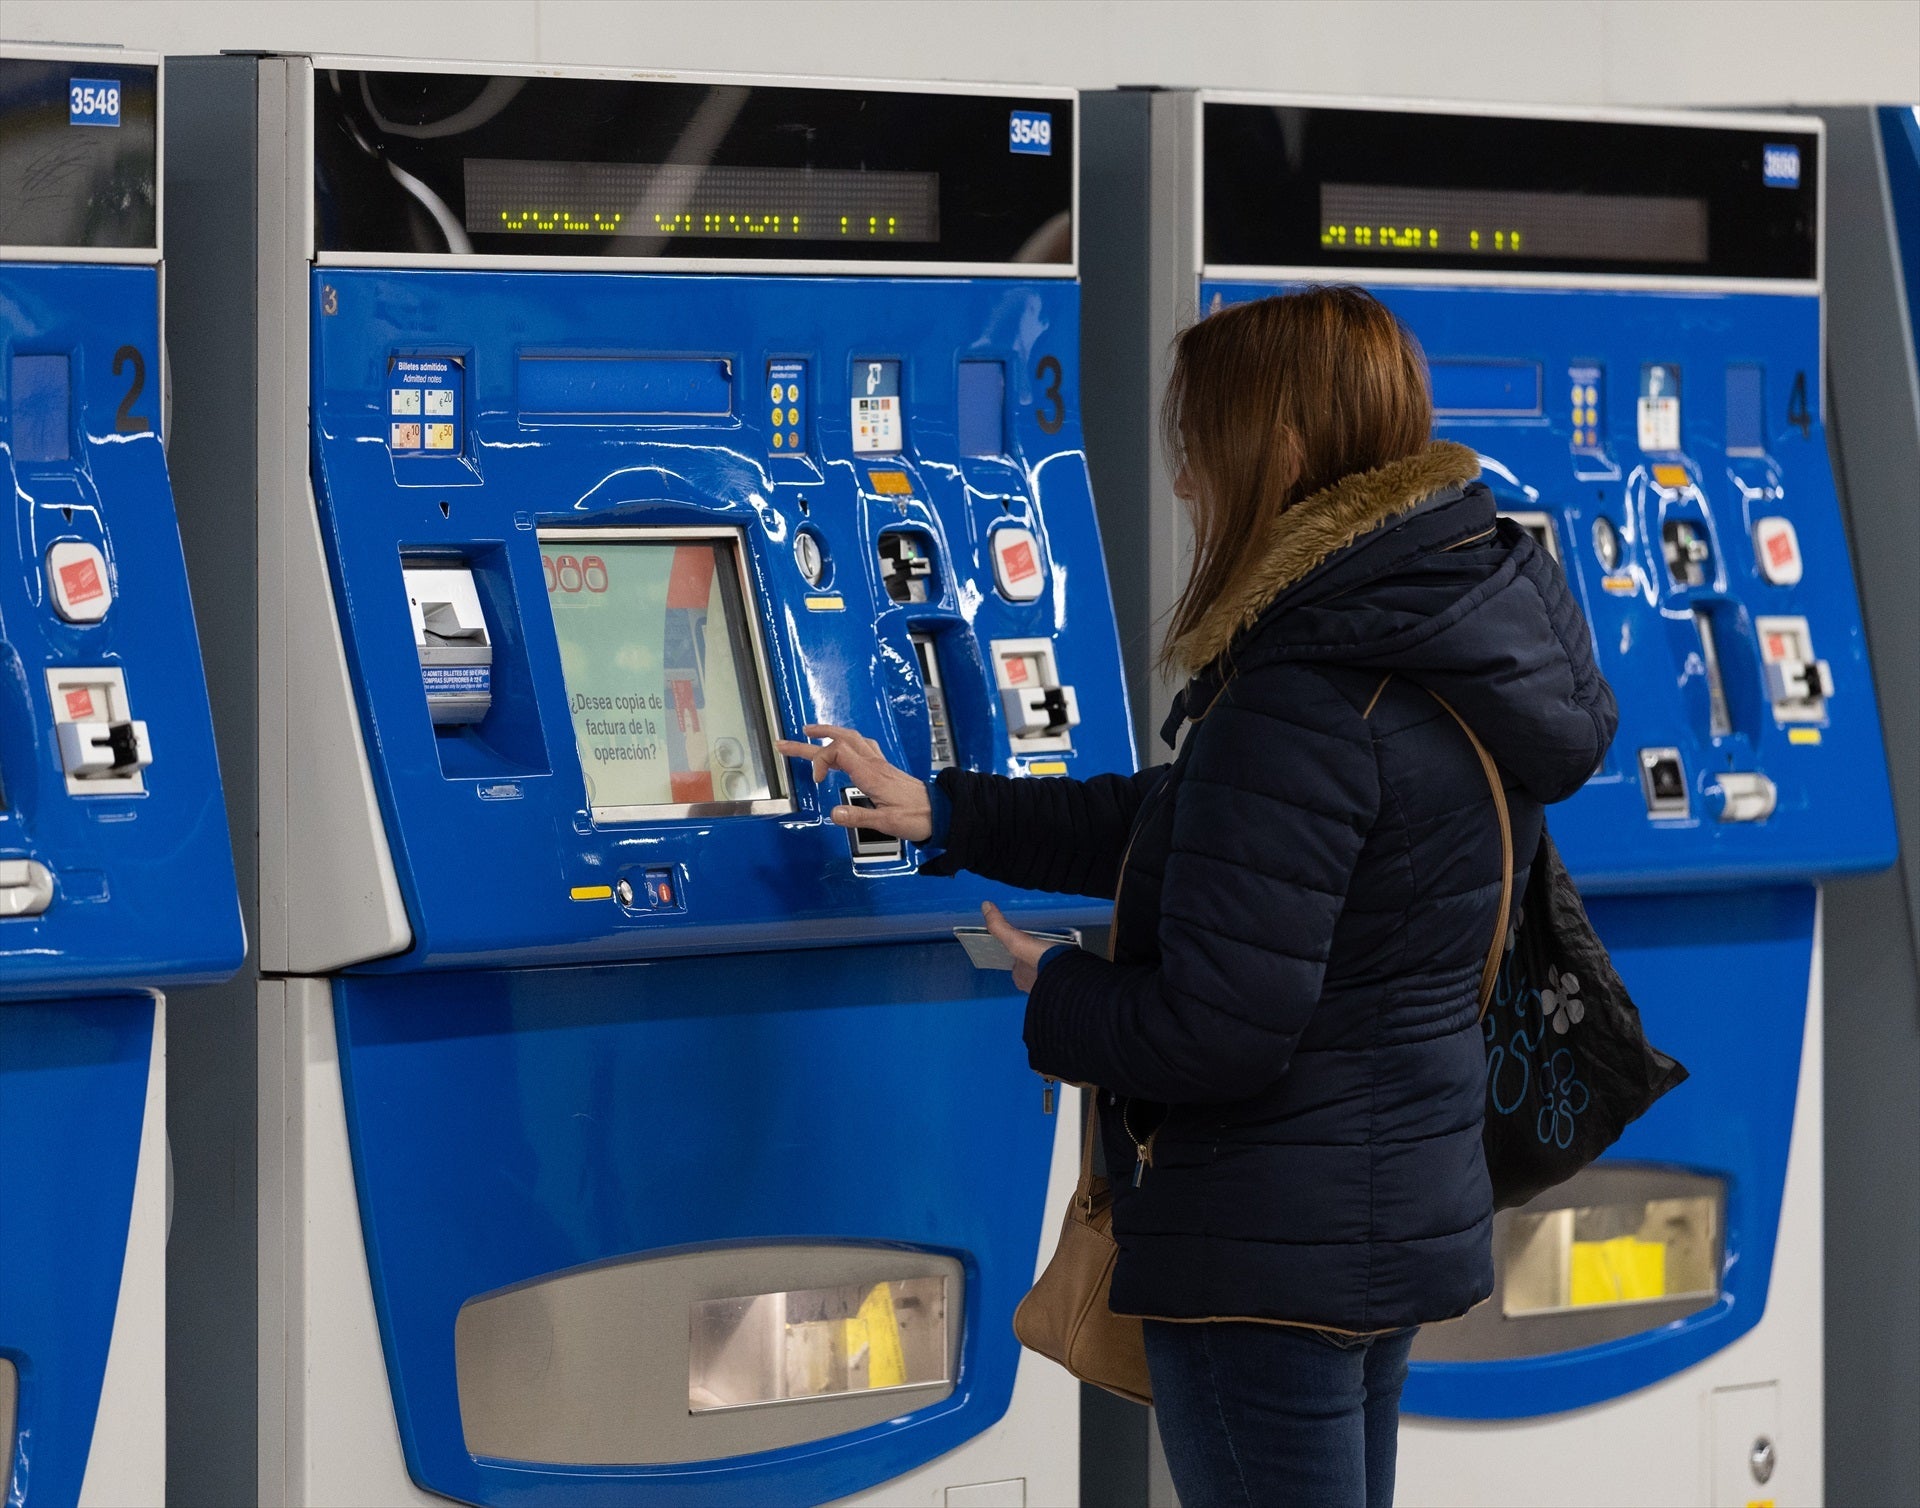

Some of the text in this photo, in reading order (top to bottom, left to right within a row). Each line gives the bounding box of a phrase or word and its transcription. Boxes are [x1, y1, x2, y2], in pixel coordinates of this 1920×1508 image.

[71, 87, 119, 116] 3548
[1011, 118, 1051, 145] 3549
[398, 362, 447, 371] Billetes admitidos
[403, 374, 442, 383] Admitted notes
[112, 345, 149, 432] 2
[415, 392, 420, 402] 5
[444, 391, 453, 403] 20
[1036, 355, 1065, 435] 3
[1788, 371, 1811, 439] 4
[412, 425, 420, 436] 10
[444, 425, 452, 436] 50
[571, 693, 663, 715] ¿Desea copia de
[586, 718, 656, 736] factura de la
[594, 744, 656, 765] operación?
